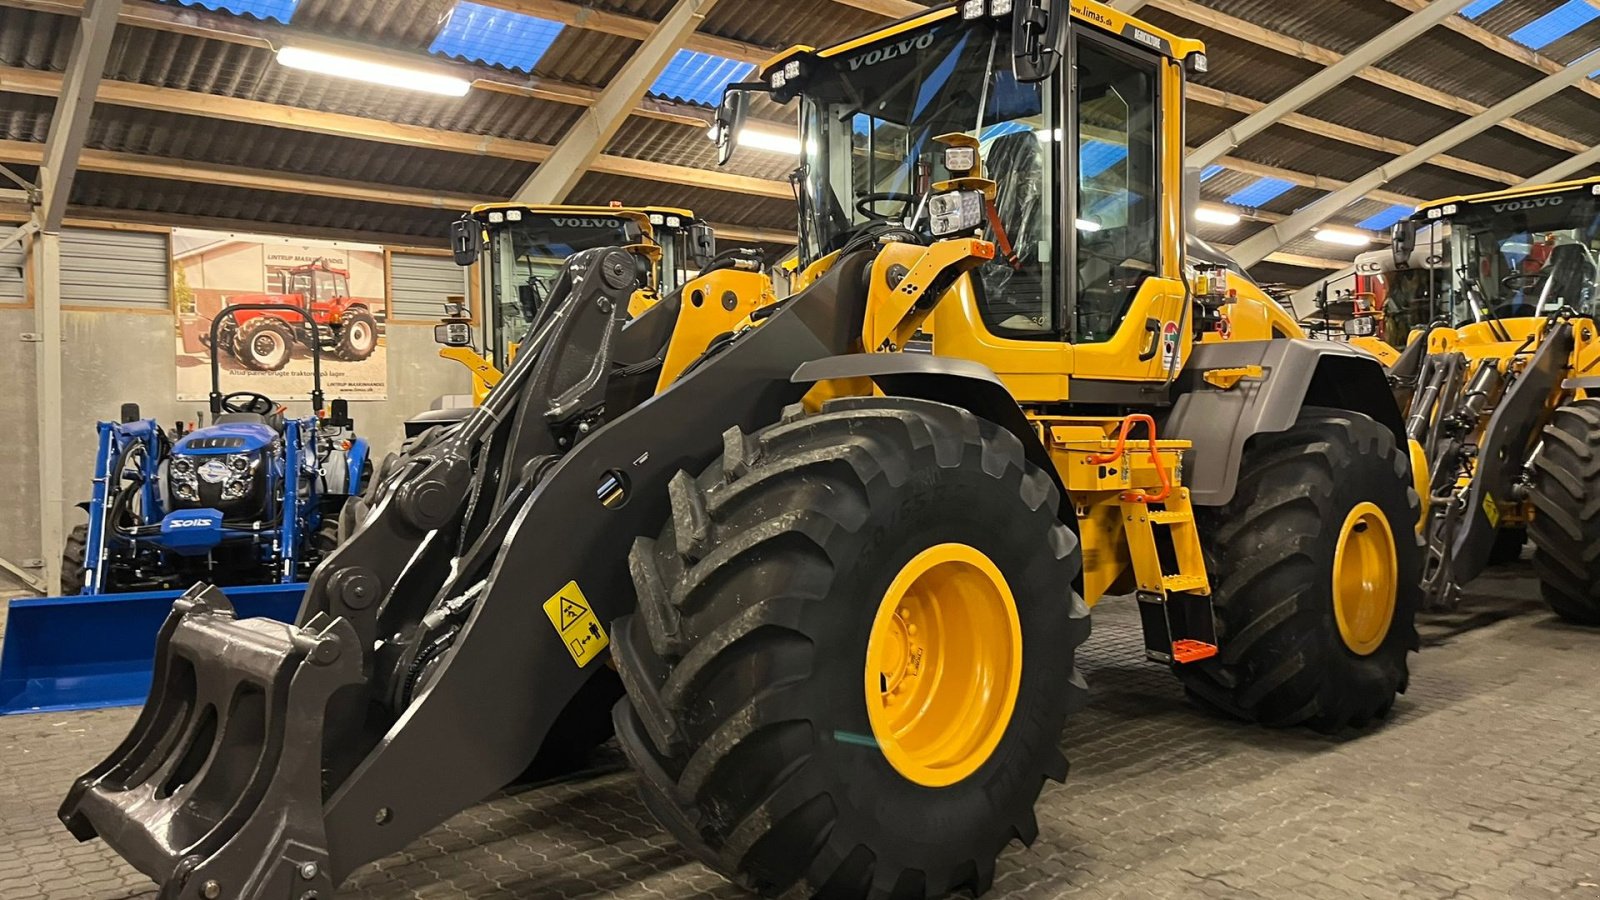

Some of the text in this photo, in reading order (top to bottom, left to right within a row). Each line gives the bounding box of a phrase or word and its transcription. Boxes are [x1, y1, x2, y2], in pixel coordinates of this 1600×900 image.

[1070, 5, 1113, 26] ww.limas.dk
[848, 33, 934, 71] VOLVO
[1492, 196, 1563, 213] VOLVO
[550, 217, 620, 227] VOLVO
[329, 370, 345, 378] lager
